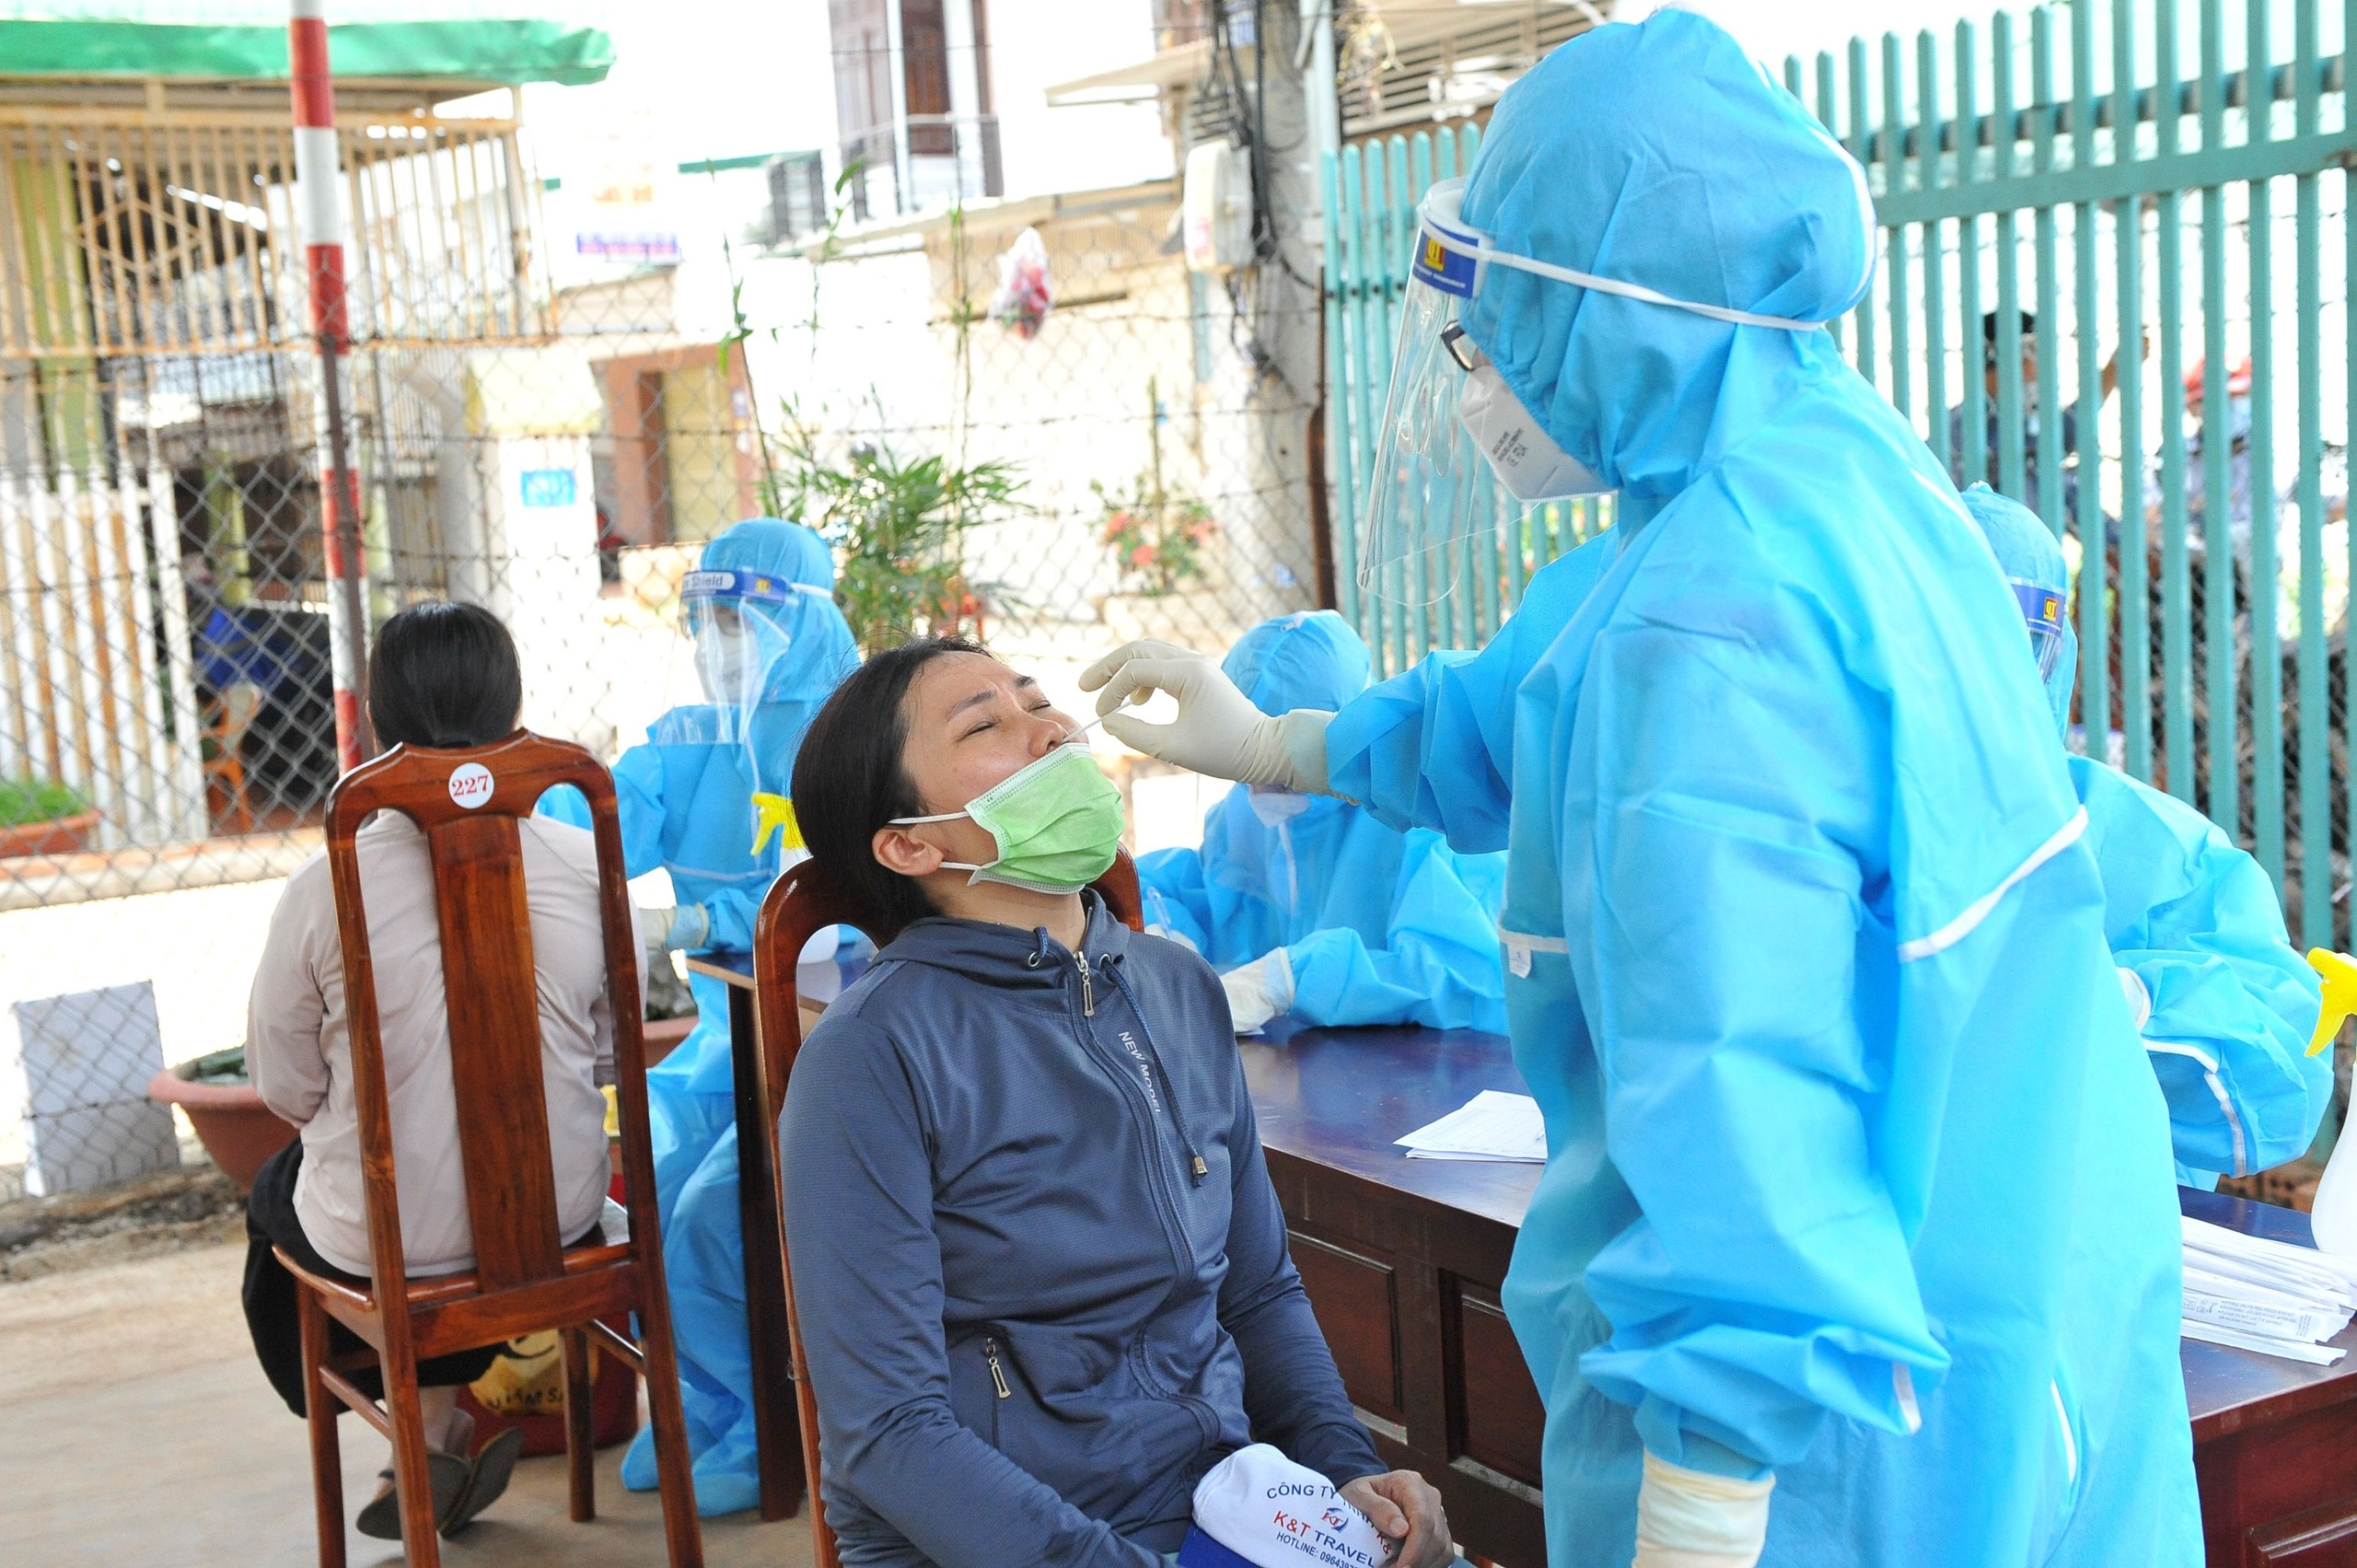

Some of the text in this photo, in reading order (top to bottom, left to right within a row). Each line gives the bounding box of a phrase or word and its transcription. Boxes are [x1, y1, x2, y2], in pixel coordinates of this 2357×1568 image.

[691, 575, 723, 587] Shield
[451, 774, 488, 796] 227
[1118, 1031, 1146, 1061] NEW
[1266, 1481, 1337, 1500] CÔNG TY
[1273, 1510, 1312, 1538] K&T
[1314, 1529, 1376, 1568] TRAVEL
[1276, 1531, 1319, 1558] HOTLINE:
